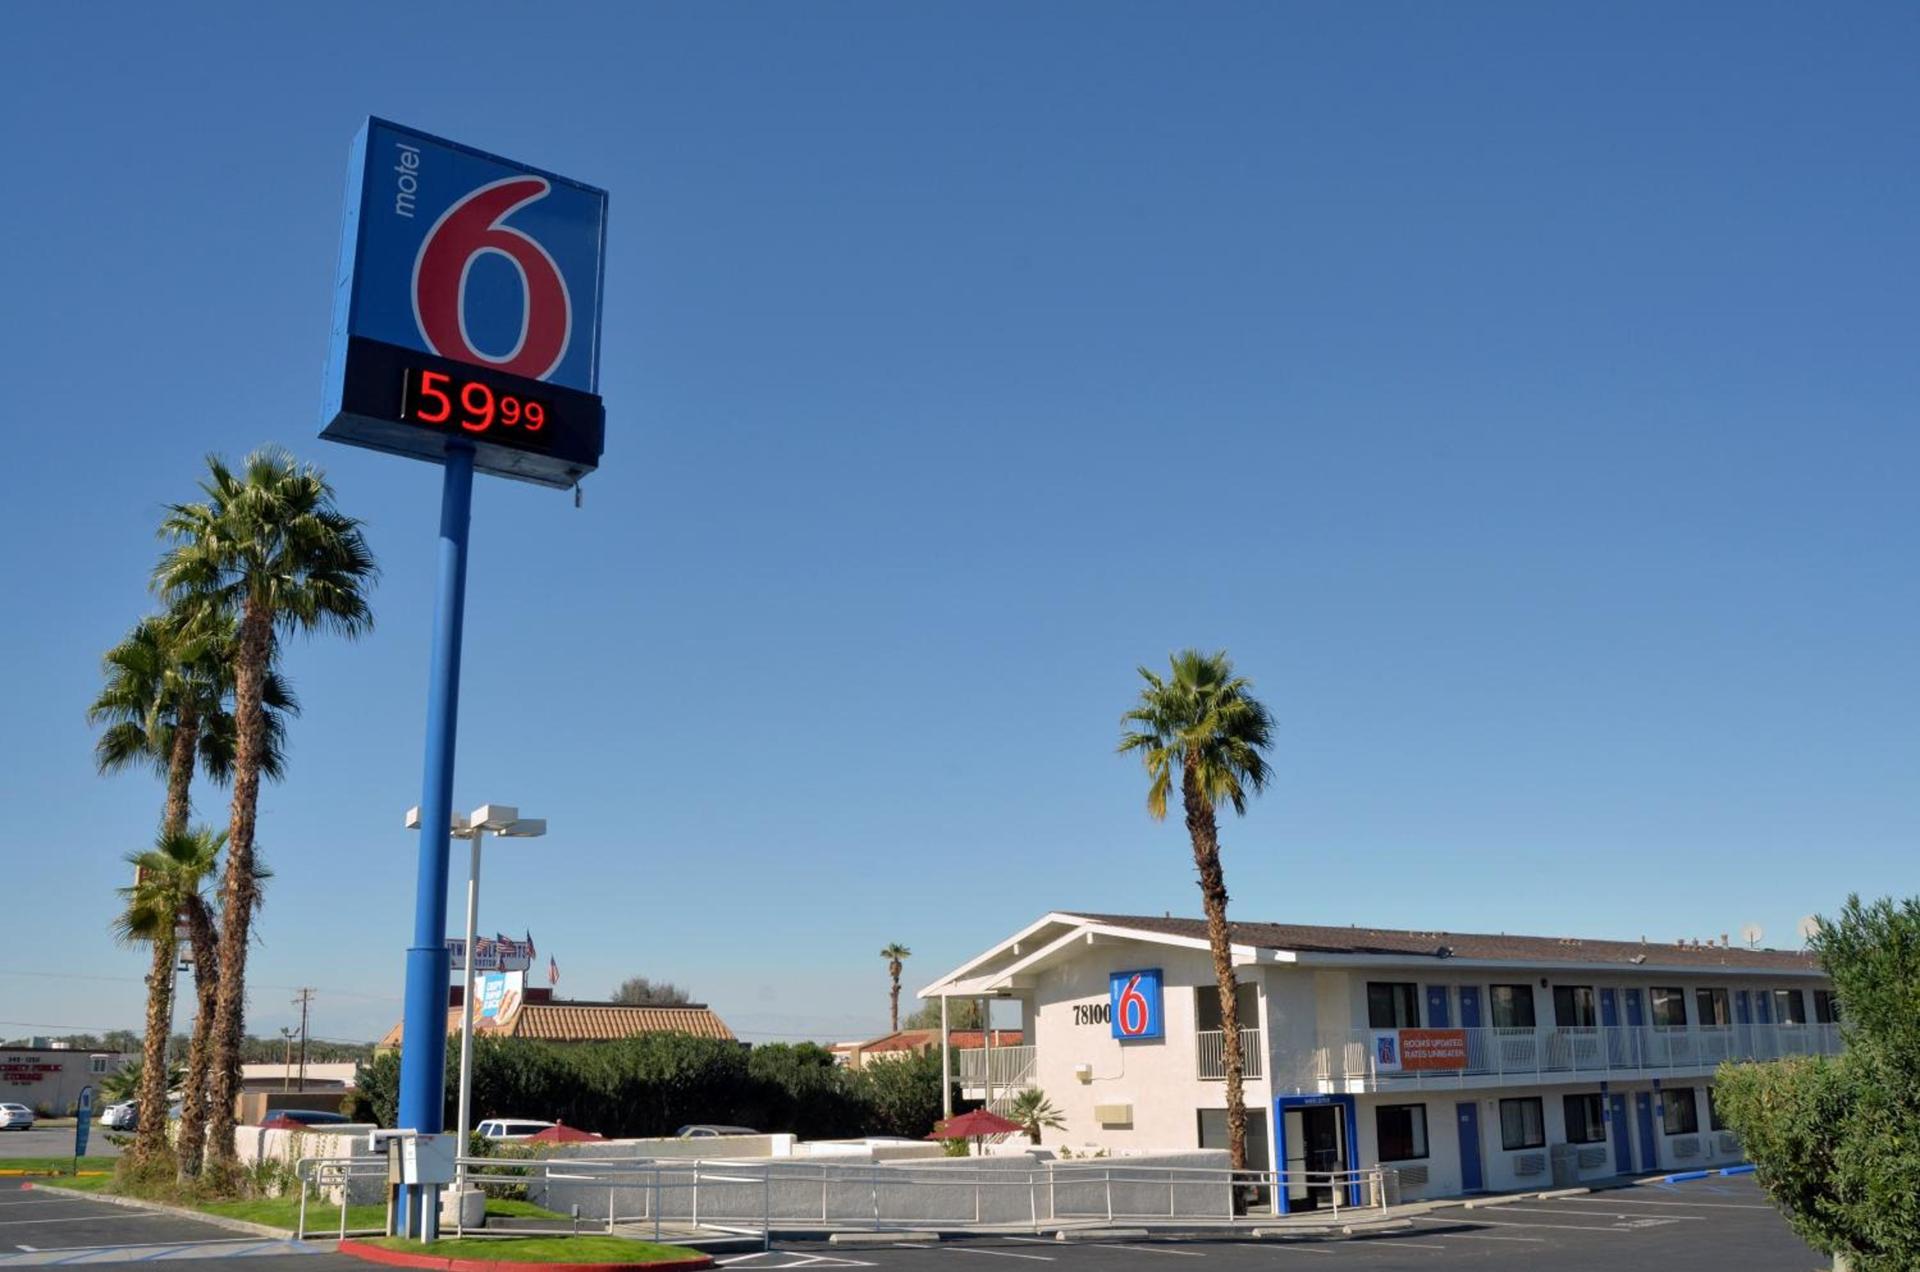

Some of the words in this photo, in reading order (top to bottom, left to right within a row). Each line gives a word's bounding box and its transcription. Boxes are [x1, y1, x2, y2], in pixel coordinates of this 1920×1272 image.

[394, 143, 421, 218] motel
[410, 174, 573, 382] 6
[1073, 1003, 1111, 1026] 78100
[1118, 973, 1149, 1036] 6
